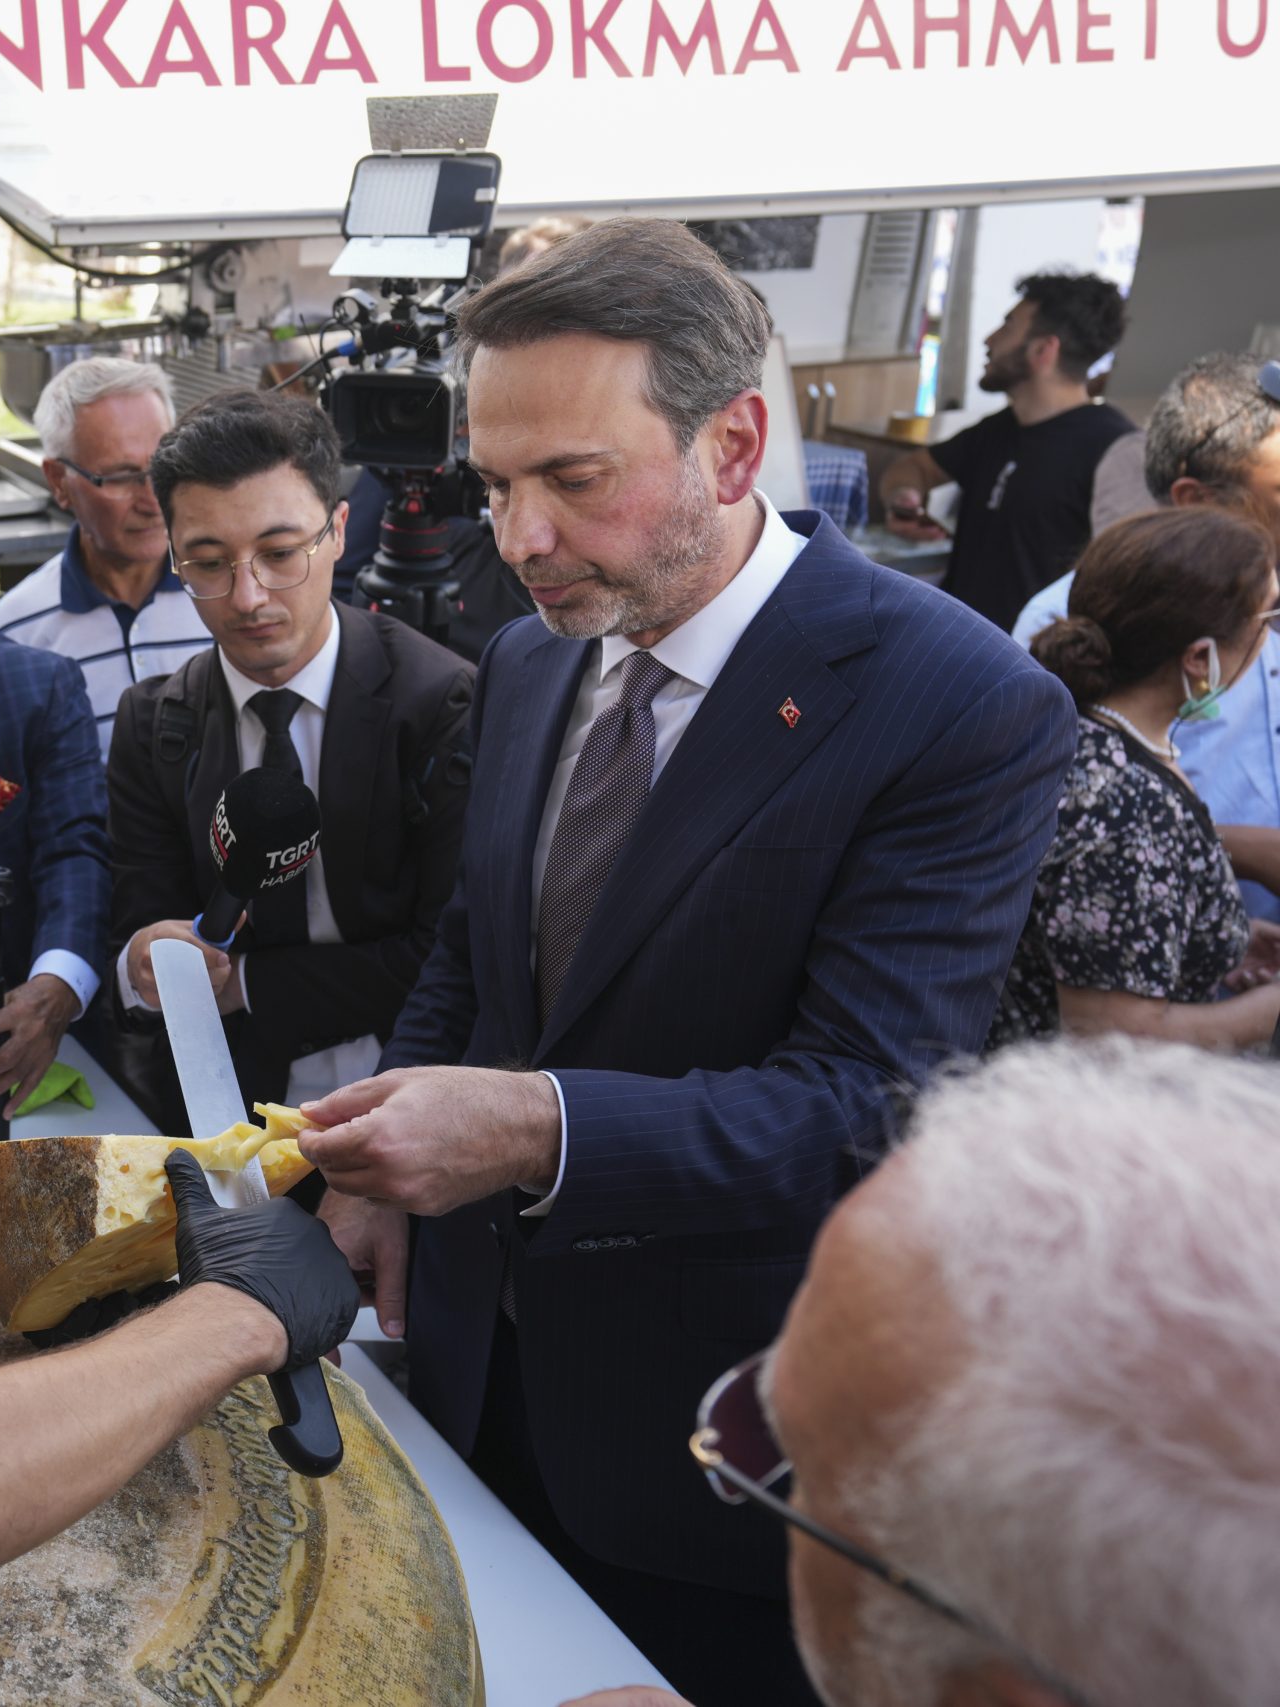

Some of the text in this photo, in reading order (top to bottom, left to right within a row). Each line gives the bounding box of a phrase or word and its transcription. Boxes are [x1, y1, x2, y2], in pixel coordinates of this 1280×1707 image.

[421, 0, 801, 83] LOKMA
[265, 830, 320, 870] TGRT
[259, 858, 312, 889] HABER
